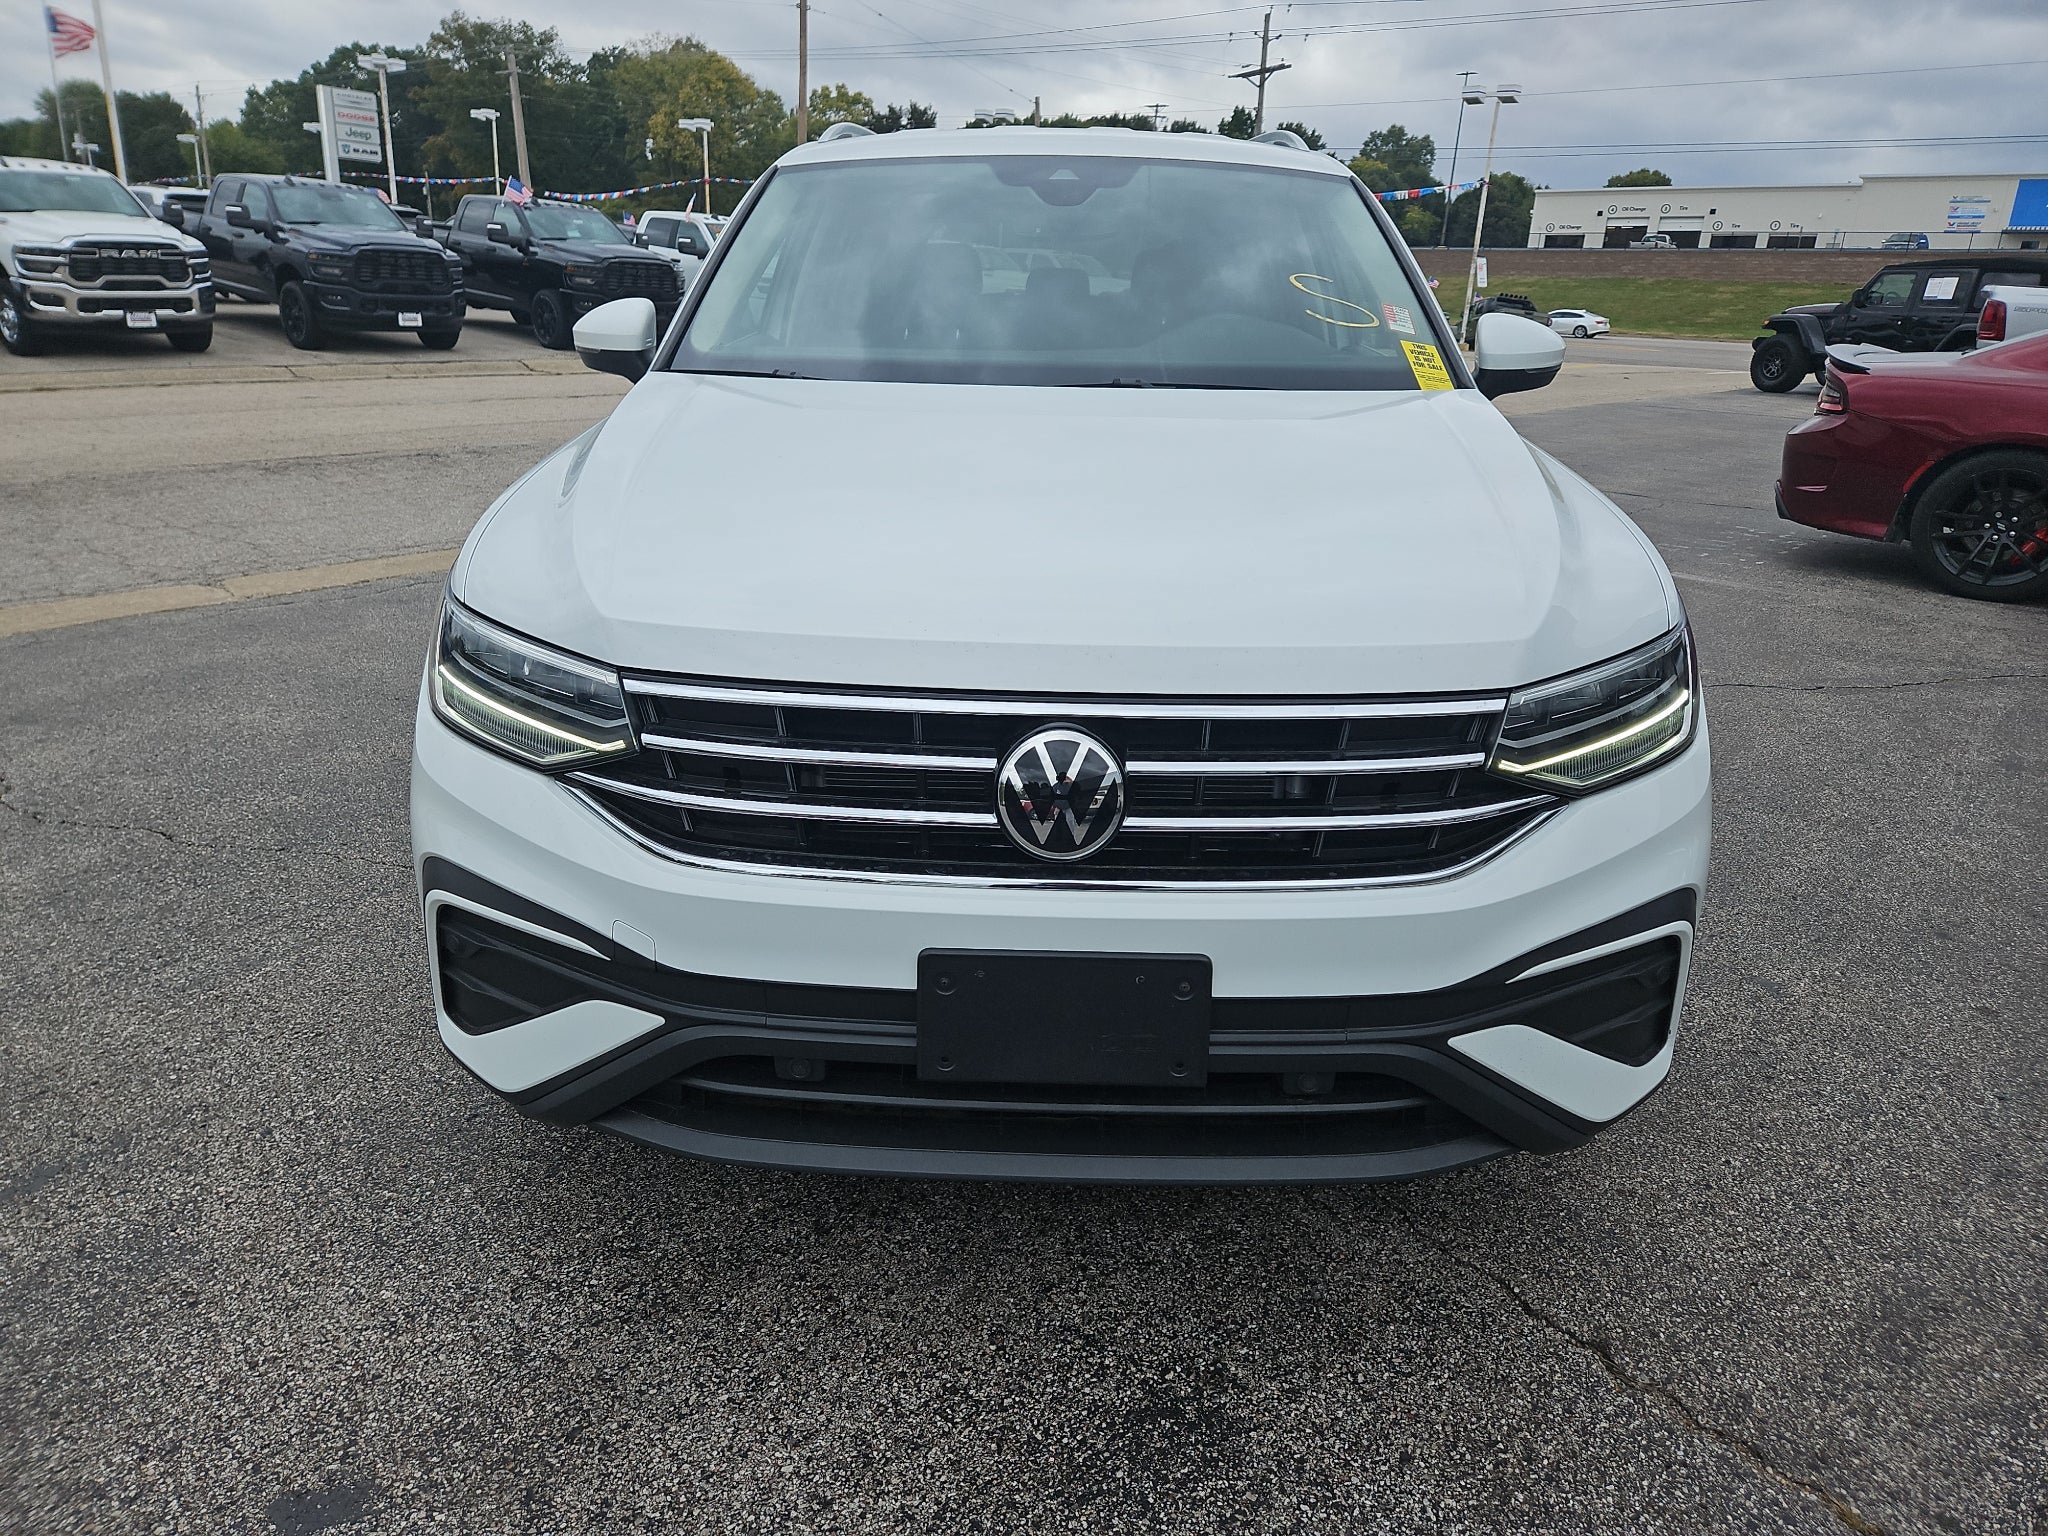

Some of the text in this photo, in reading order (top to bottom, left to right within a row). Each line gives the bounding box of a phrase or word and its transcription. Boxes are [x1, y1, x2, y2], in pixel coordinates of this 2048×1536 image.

[345, 127, 372, 140] Jeep
[100, 248, 158, 259] RAM
[1288, 273, 1381, 328] S
[1411, 343, 1427, 351] THIS
[1408, 349, 1436, 358] VEHICLE
[1427, 363, 1444, 371] SALE
